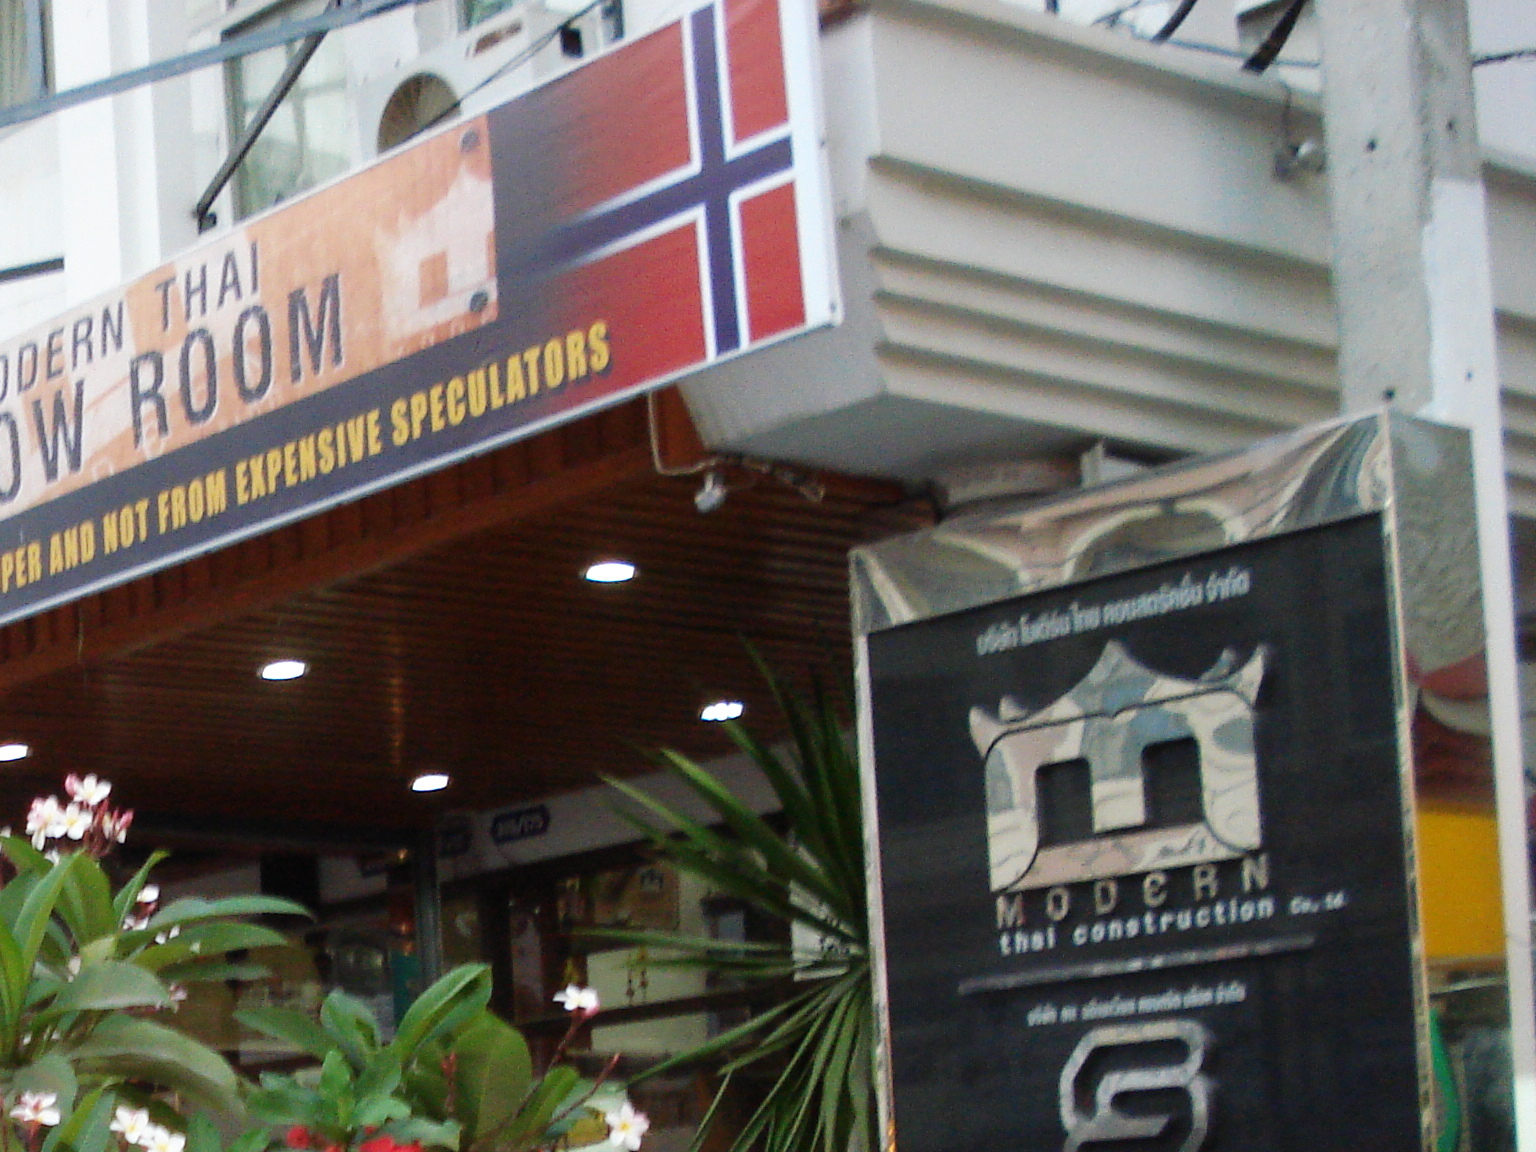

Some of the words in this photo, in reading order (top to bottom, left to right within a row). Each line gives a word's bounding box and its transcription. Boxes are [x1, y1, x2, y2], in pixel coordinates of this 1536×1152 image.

[154, 241, 260, 333] THAI
[129, 272, 343, 450] ROOM
[49, 520, 96, 576] AND
[102, 499, 149, 554] NOT
[157, 467, 228, 534] FROM
[235, 408, 382, 506] EXPENSIVE
[390, 320, 610, 448] SPECULATORS
[999, 925, 1057, 956] thai
[1072, 897, 1275, 945] construction
